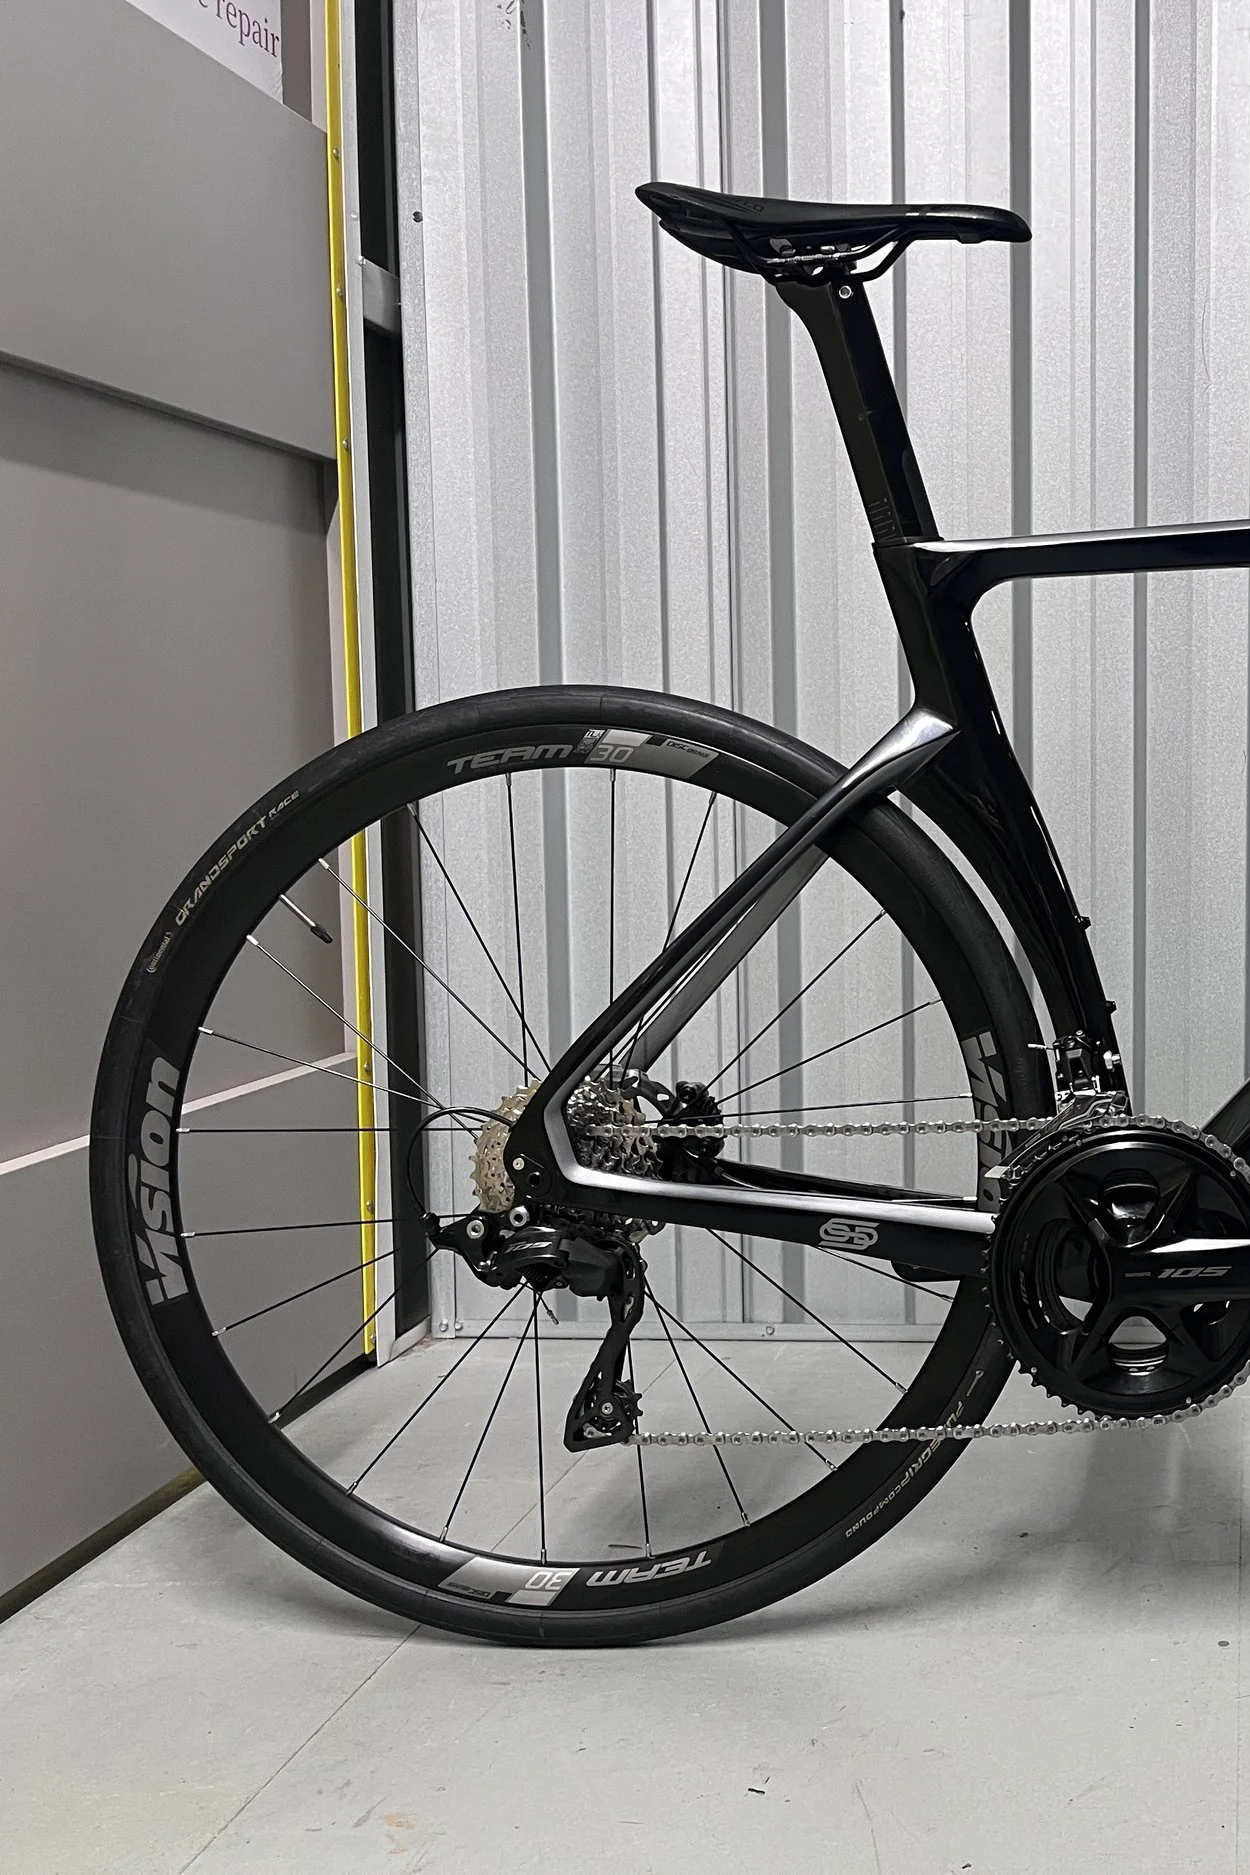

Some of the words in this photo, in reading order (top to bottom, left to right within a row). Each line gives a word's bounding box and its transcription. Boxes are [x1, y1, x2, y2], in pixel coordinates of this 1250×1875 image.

[216, 0, 280, 58] repair
[448, 744, 573, 775] TEAM
[589, 744, 634, 763] 30
[175, 815, 267, 926] GRANDSPORT
[268, 790, 300, 819] RACE
[1157, 1266, 1232, 1279] 105
[899, 1400, 965, 1488] PUEGRIP
[845, 1484, 901, 1538] COMPOUND
[524, 1570, 572, 1590] 30
[586, 1551, 712, 1587] TEAM
